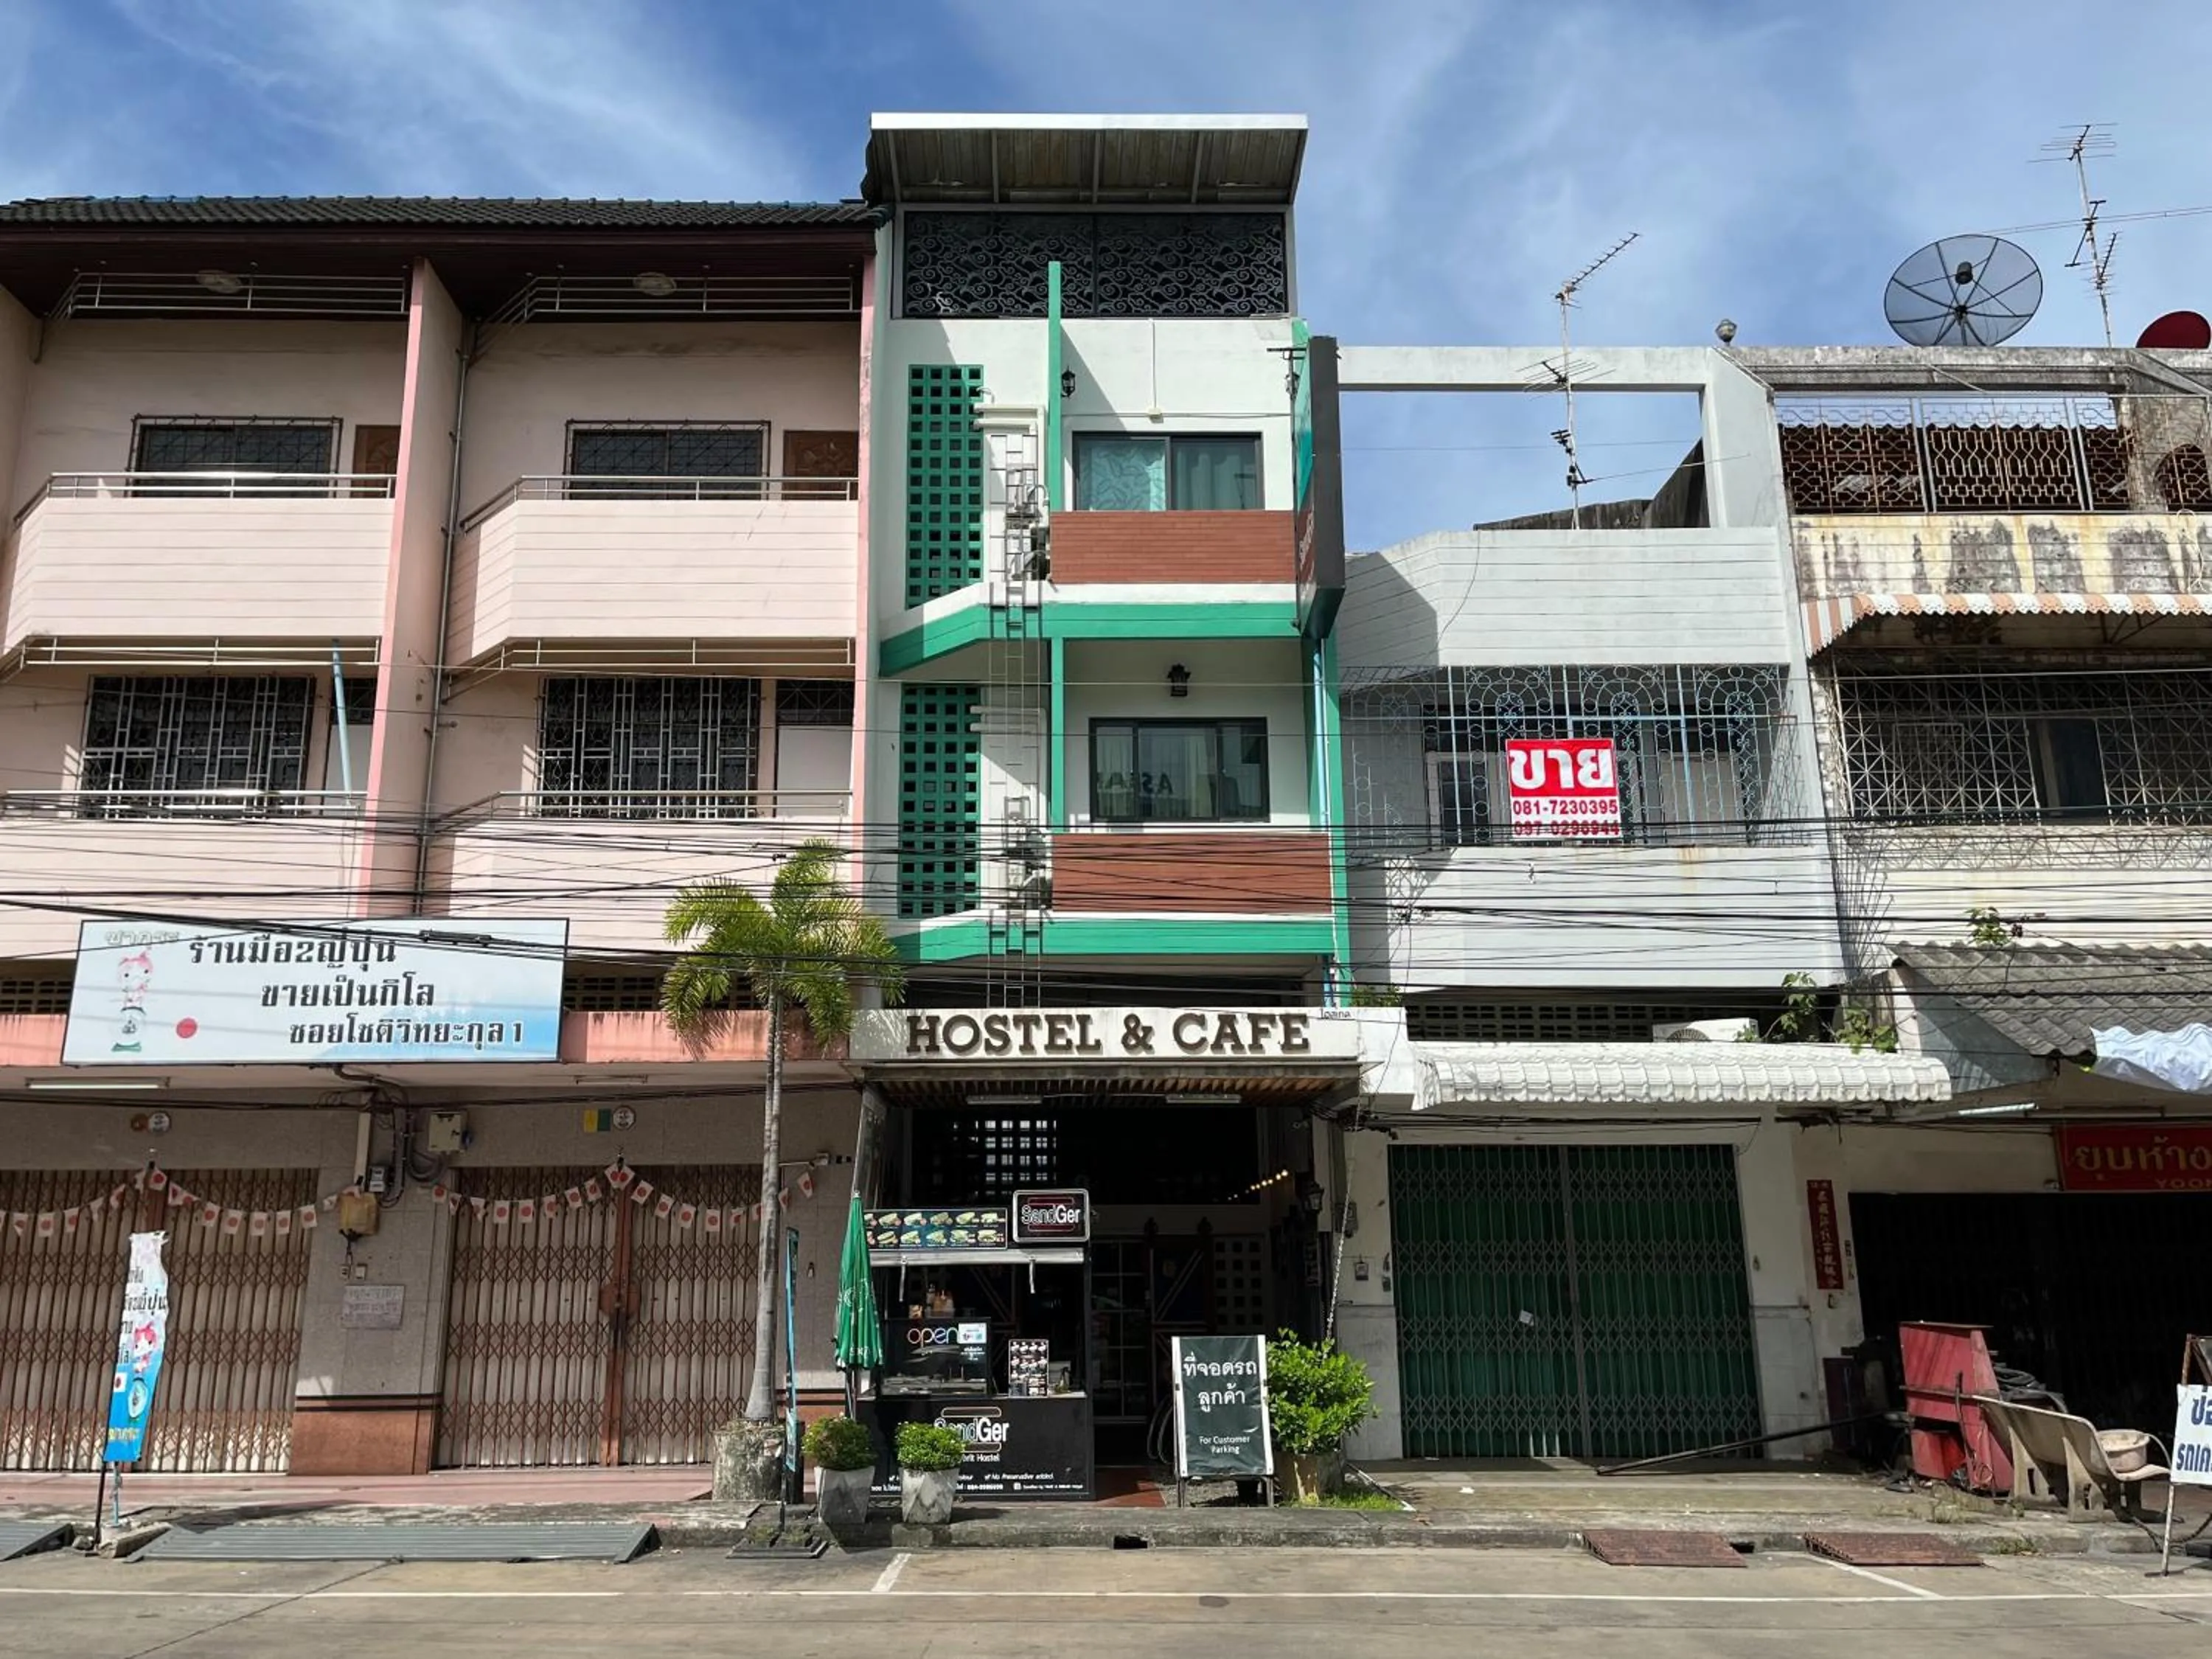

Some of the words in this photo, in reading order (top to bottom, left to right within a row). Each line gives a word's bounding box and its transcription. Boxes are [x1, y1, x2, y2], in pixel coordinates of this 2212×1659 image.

[1509, 748, 1615, 790] ขาย
[1512, 799, 1618, 815] 081-7230395
[261, 970, 434, 1007] ขายเป็นกิโล
[906, 1014, 1102, 1054] HOSTEL
[1120, 1013, 1154, 1052] &
[1172, 1012, 1310, 1052] CAFE
[907, 1327, 959, 1349] open
[1183, 1351, 1257, 1377] ที่จอดรถ
[1198, 1382, 1245, 1413] ลูกค้า
[1200, 1436, 1211, 1444] For
[1214, 1436, 1251, 1444] Customer
[1211, 1444, 1239, 1455] Parking
